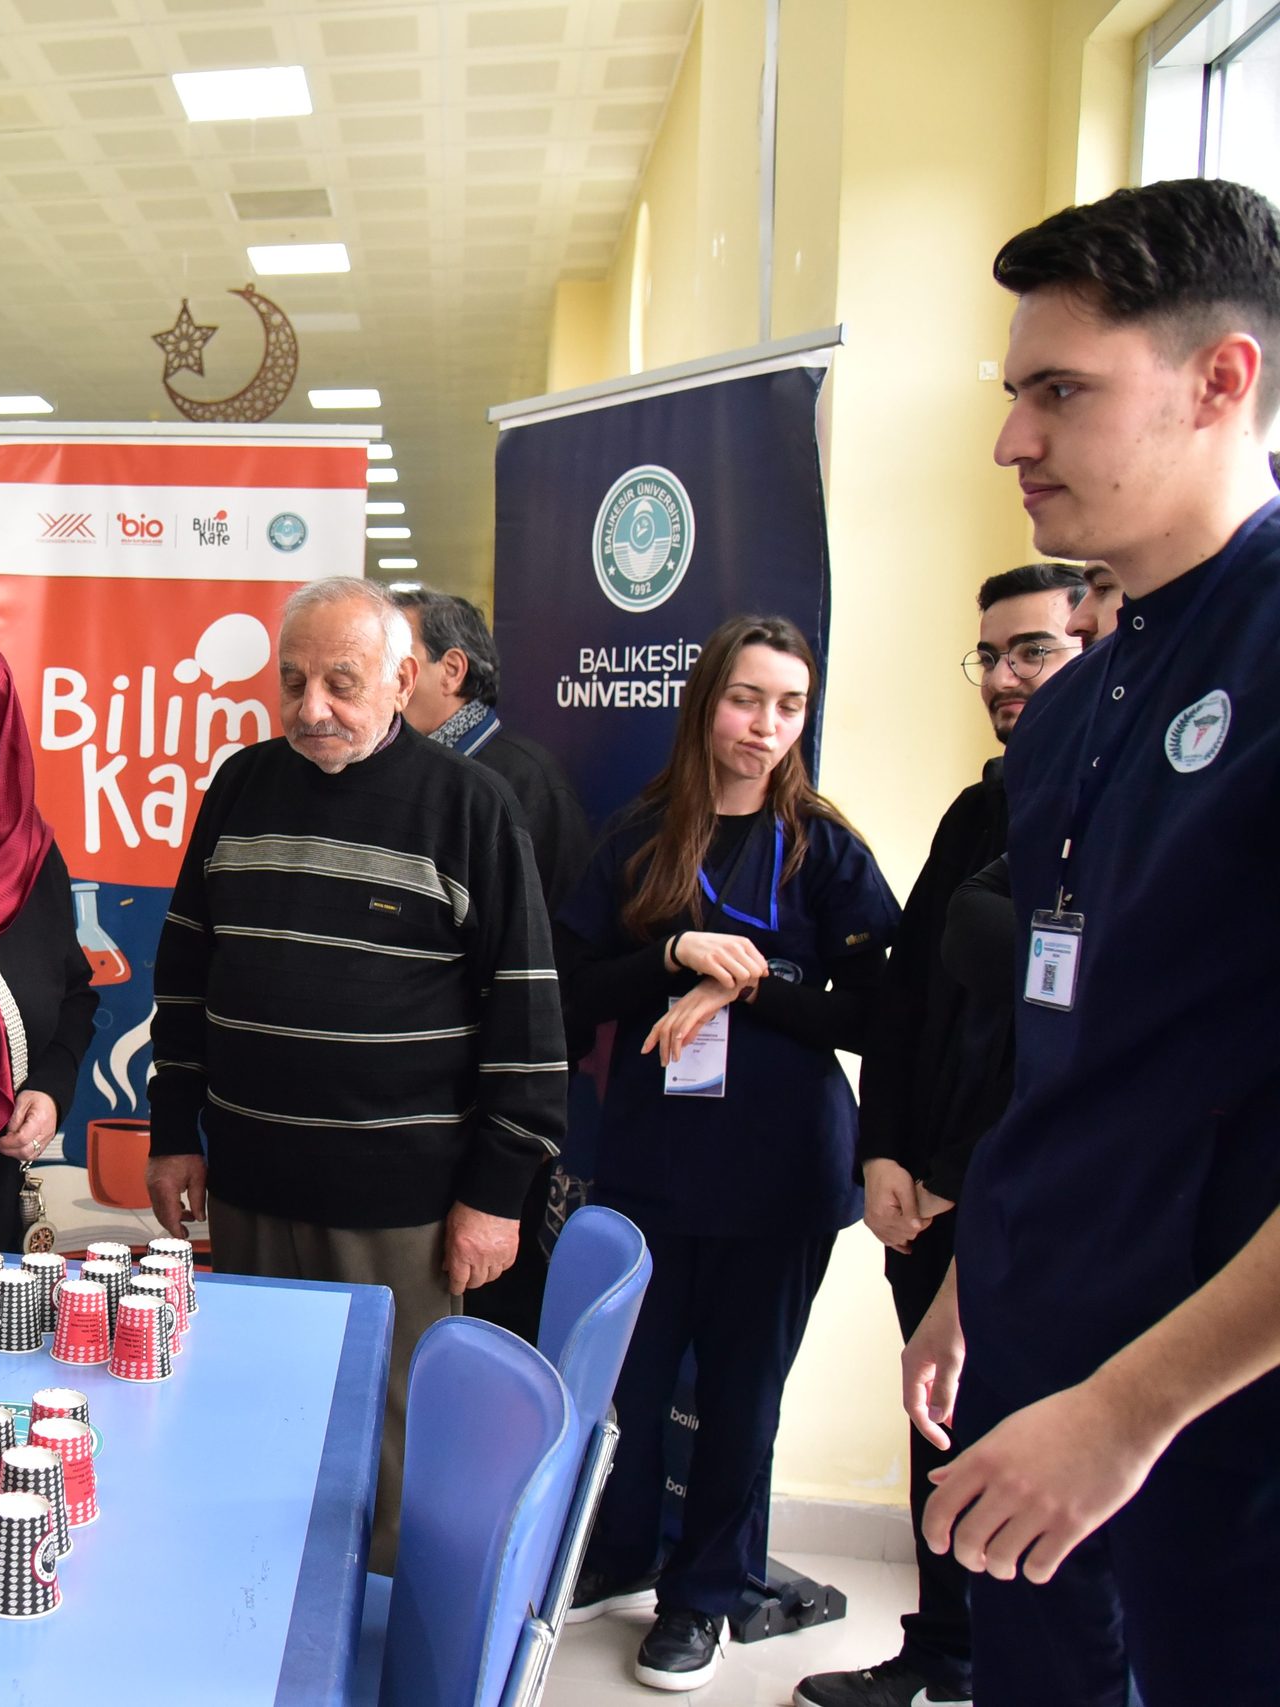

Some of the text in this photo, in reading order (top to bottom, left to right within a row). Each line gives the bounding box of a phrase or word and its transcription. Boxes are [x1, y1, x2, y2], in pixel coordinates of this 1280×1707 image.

[117, 513, 163, 538] bio
[193, 517, 228, 533] Bilim
[604, 488, 635, 554] BALIKESİR
[199, 530, 231, 546] Kafe
[630, 582, 652, 595] 1992
[556, 672, 687, 708] ÜNİVERSİT
[40, 658, 272, 764] Bilim
